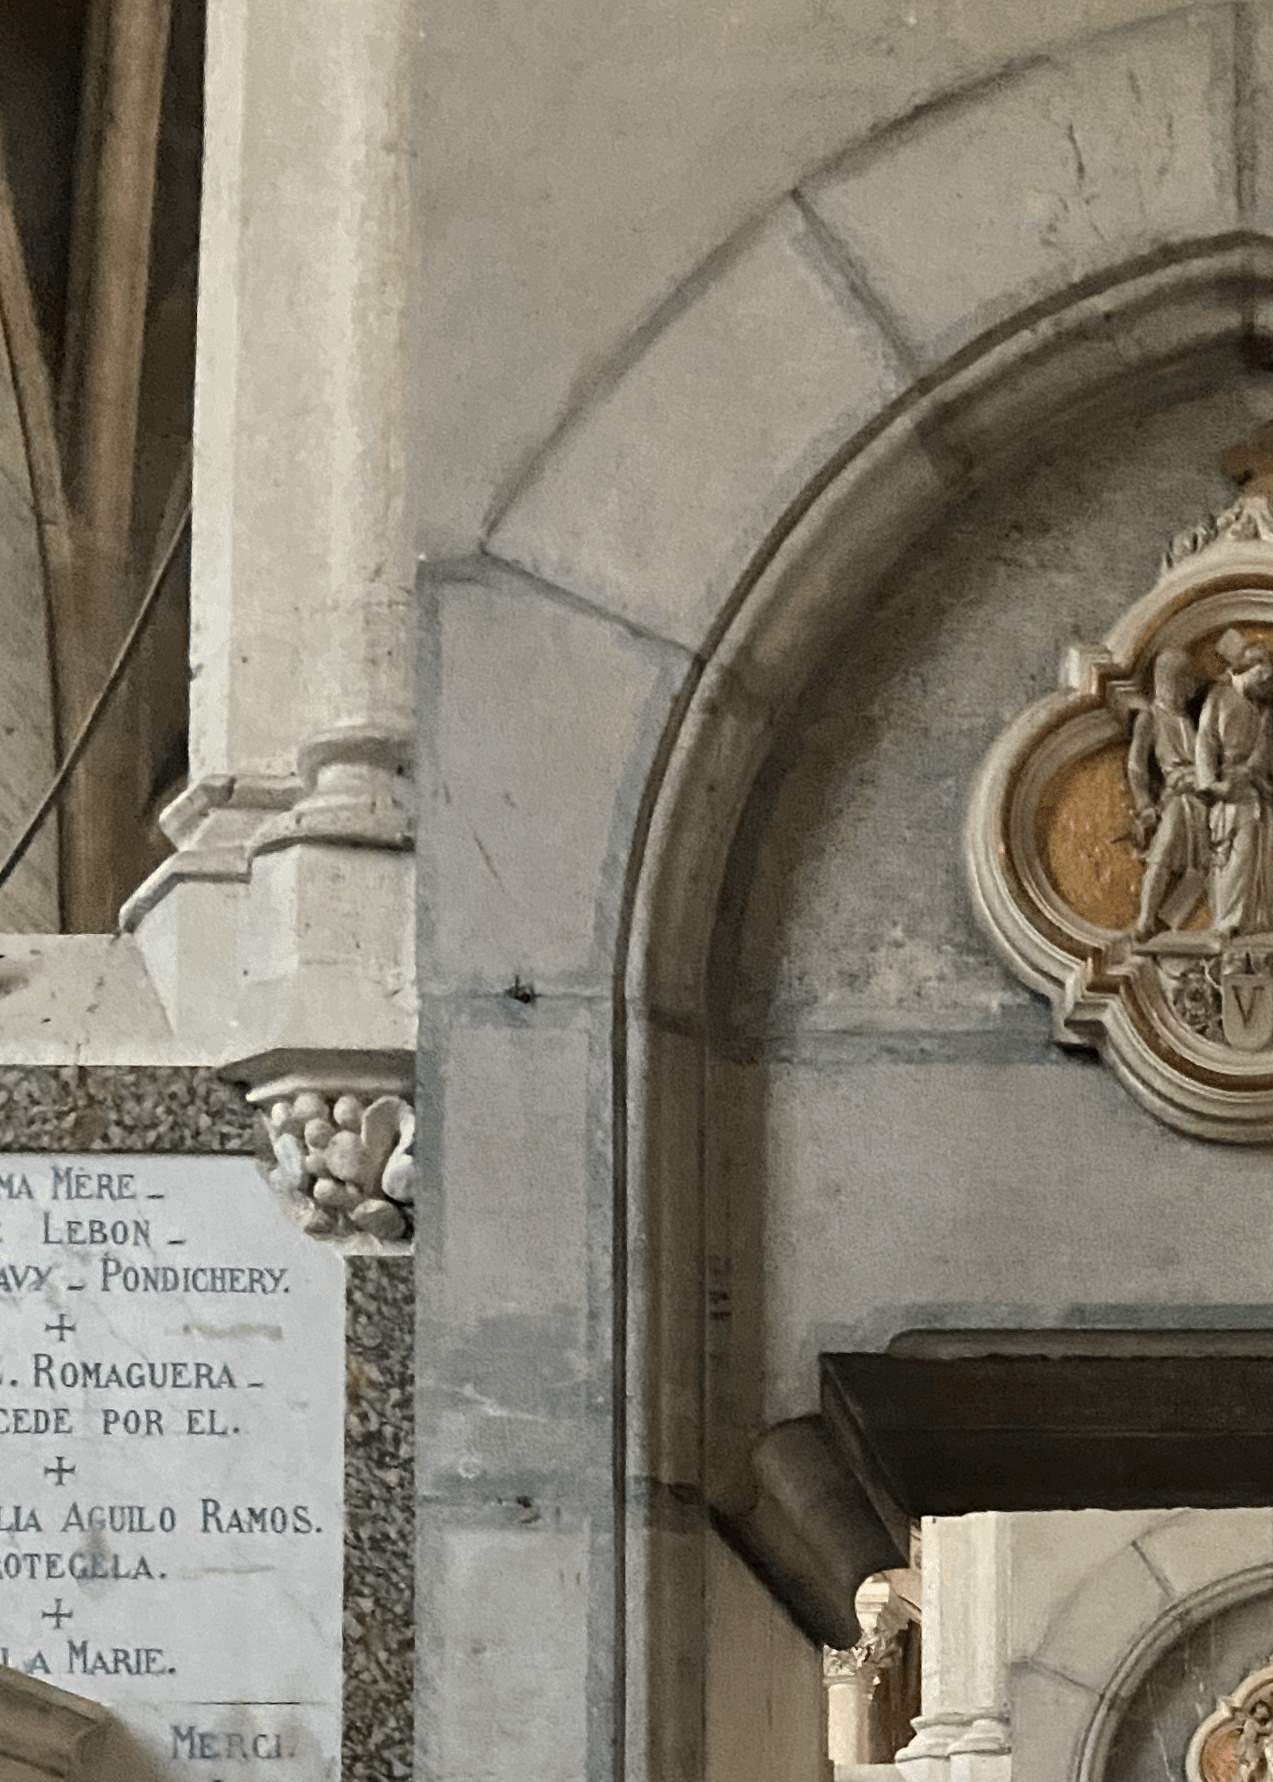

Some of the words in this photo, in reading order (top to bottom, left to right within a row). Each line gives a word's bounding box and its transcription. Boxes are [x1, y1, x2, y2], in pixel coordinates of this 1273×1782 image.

[1231, 984, 1265, 1029] V
[43, 1212, 151, 1246] LEBON
[101, 1256, 290, 1295] PONDICHERY.
[32, 1353, 237, 1390] ROMAGUERA
[102, 1408, 164, 1435] POR
[186, 1409, 240, 1435] EL.
[60, 1502, 177, 1533] AGUILO
[201, 1499, 323, 1534] RAMOS.
[67, 1640, 177, 1675] MARIE.
